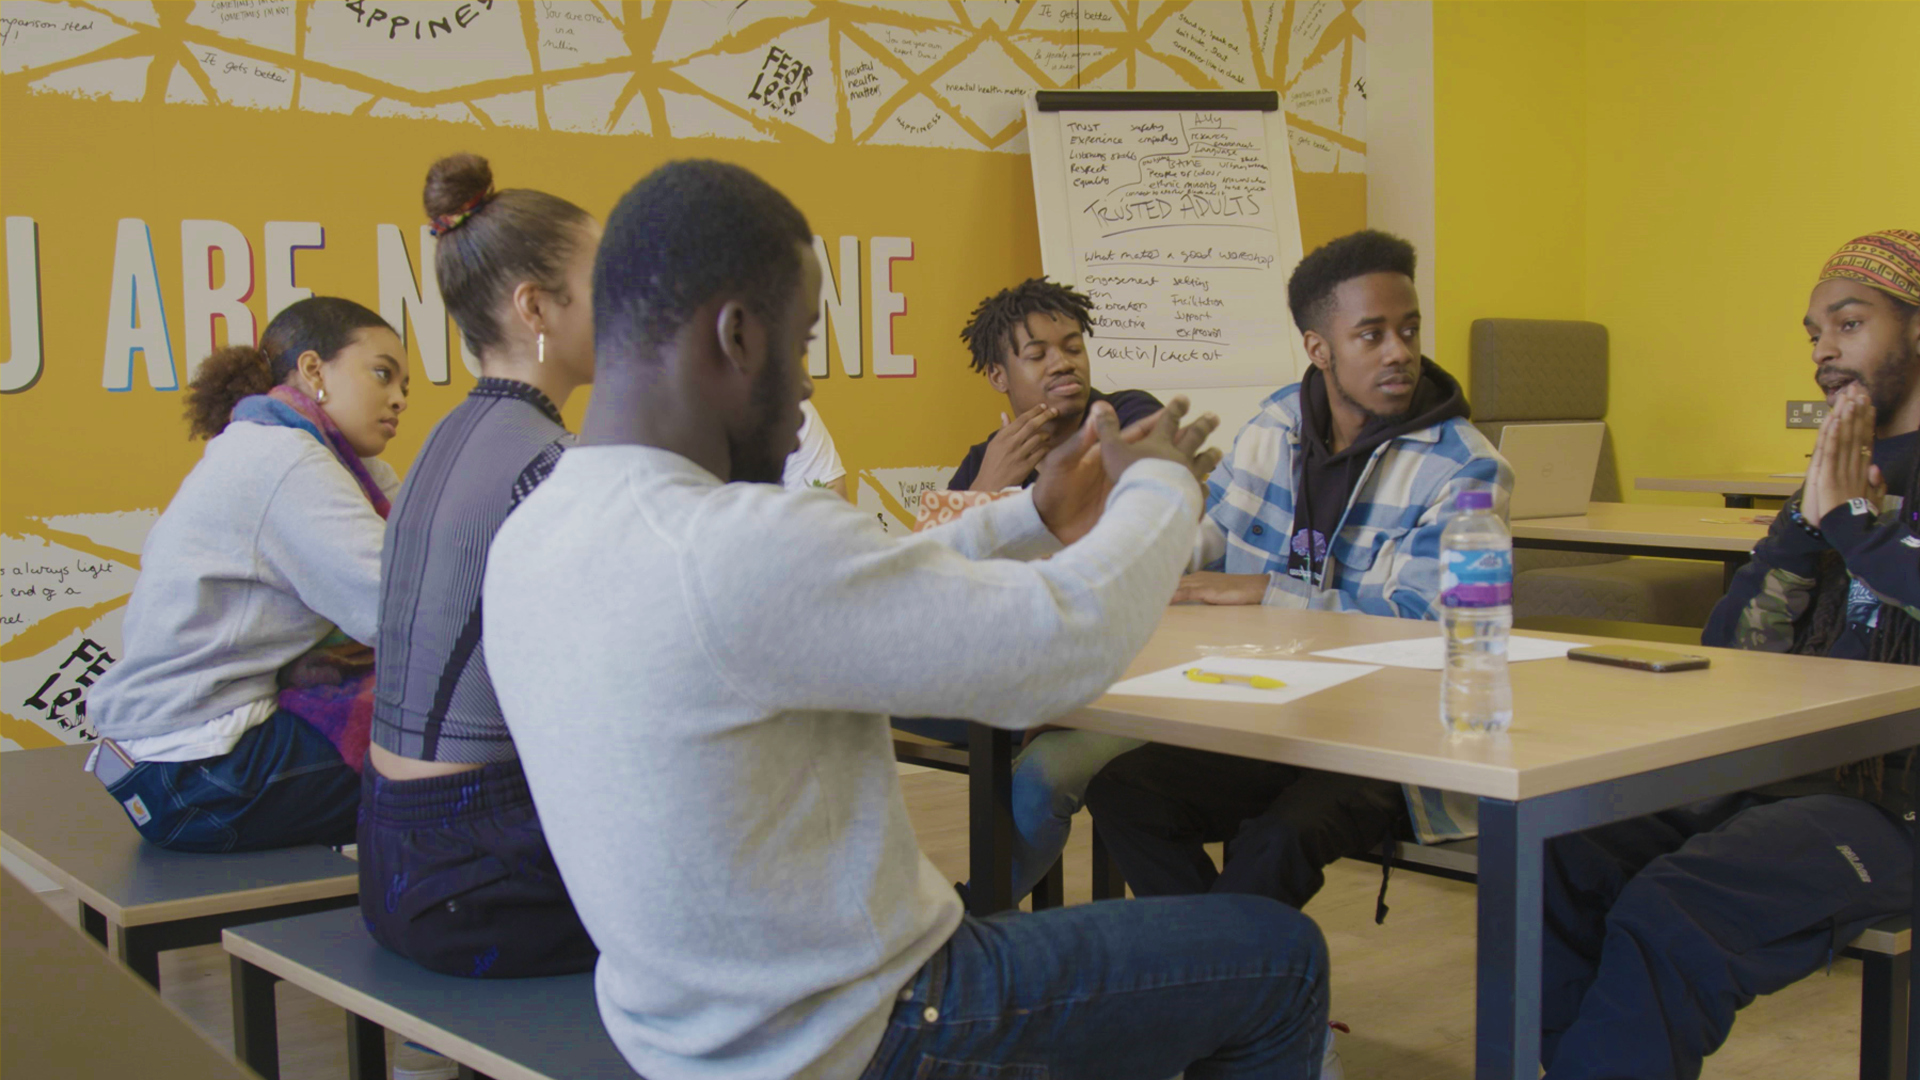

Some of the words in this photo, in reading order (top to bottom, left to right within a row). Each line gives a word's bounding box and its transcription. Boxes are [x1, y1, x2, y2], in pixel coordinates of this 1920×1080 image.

[345, 0, 491, 40] APPINE
[1038, 4, 1052, 18] It
[1059, 8, 1079, 23] gets
[1084, 9, 1112, 21] better
[0, 17, 57, 35] mparison
[200, 51, 217, 66] It
[223, 61, 248, 74] gets
[254, 66, 287, 83] better
[844, 60, 874, 79] mental
[945, 82, 976, 93] mental
[1083, 198, 1173, 227] TRUSTED
[1180, 193, 1261, 220] ADULTS
[898, 481, 917, 499] YOU
[12, 561, 70, 584] always
[76, 558, 113, 580] light
[10, 585, 36, 597] end
[64, 587, 82, 596] a
